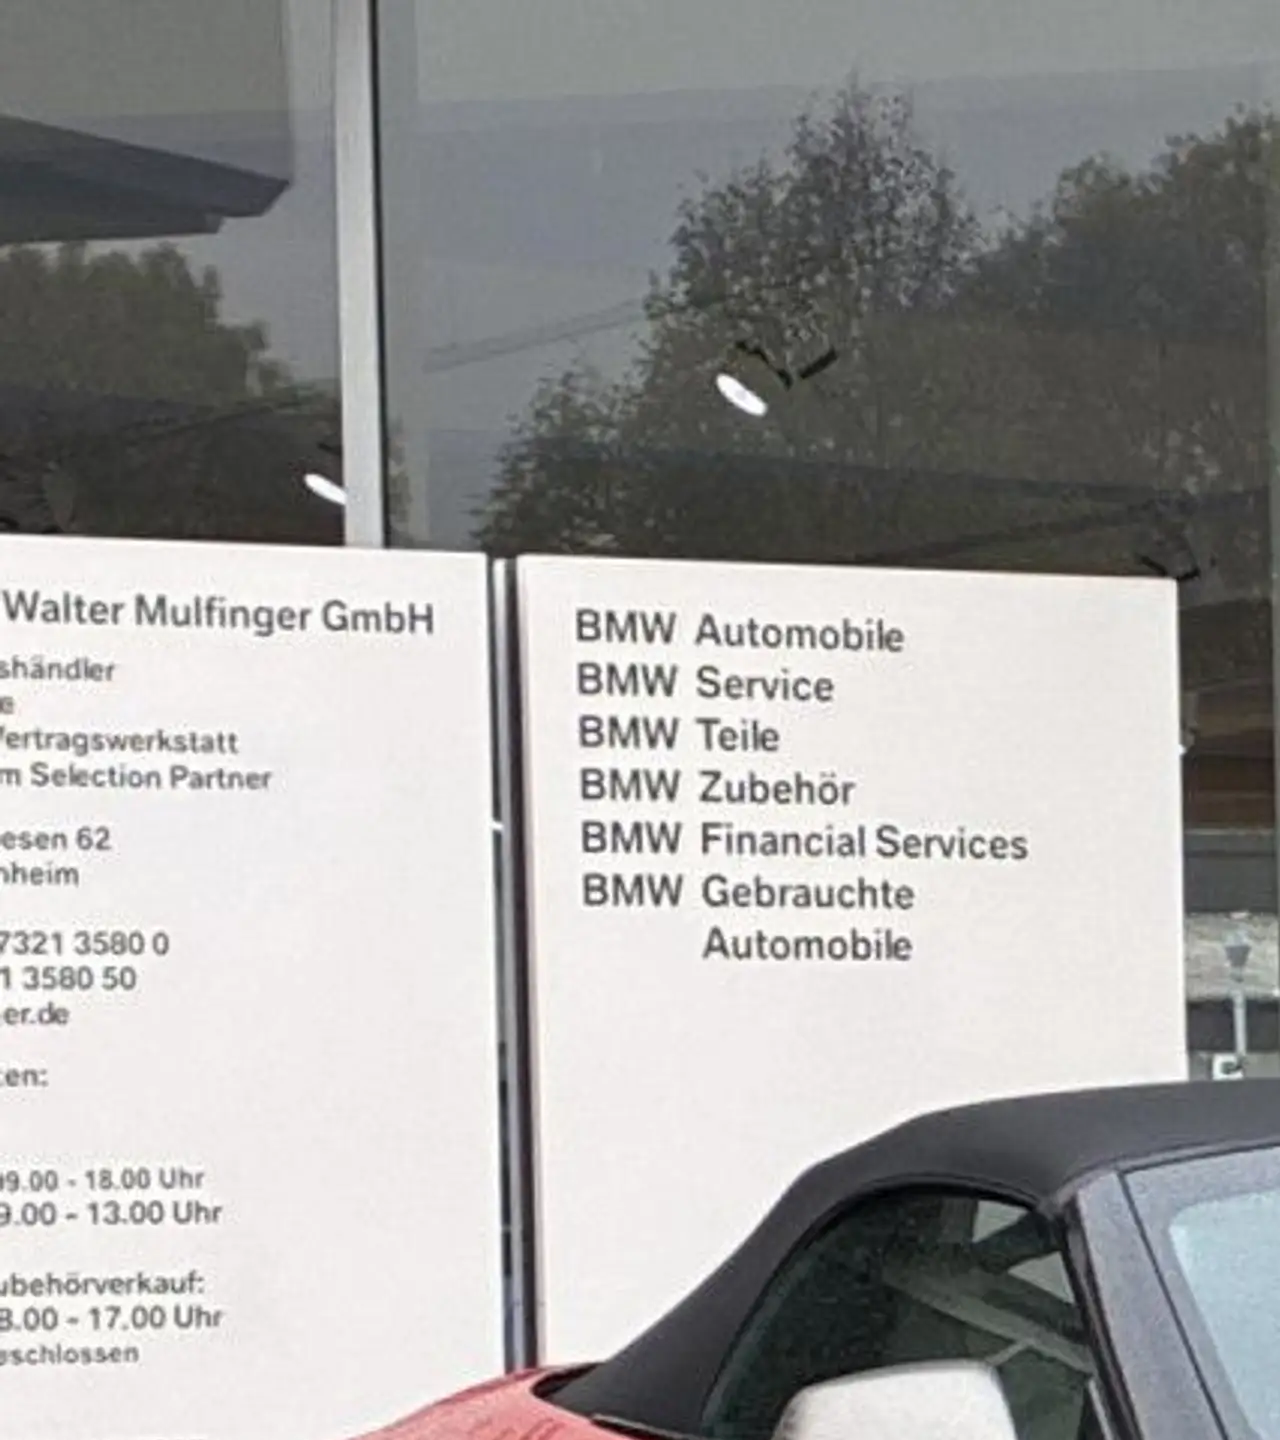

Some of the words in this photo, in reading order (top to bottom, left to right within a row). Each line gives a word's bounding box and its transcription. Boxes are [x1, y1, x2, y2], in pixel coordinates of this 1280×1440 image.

[2, 589, 125, 626] Walter
[135, 593, 312, 638] Mulfinger
[321, 599, 434, 635] GmbH
[575, 608, 677, 645] BMW
[694, 612, 905, 653] Automobile
[577, 661, 678, 698] BMW
[696, 664, 835, 703] Service
[0, 725, 238, 757] ertragswerkstatt
[578, 714, 680, 750] BMW
[695, 717, 780, 753] Teile
[30, 761, 162, 789] Selection
[169, 765, 272, 791] Partner
[580, 767, 681, 803] BMW
[699, 769, 856, 806] Zubehör
[75, 826, 111, 851] 62
[581, 819, 683, 855] BMW
[701, 821, 866, 858] Financial
[875, 825, 1029, 861] Services
[582, 872, 684, 907] BMW
[701, 873, 915, 911] Gebrauchte
[74, 930, 146, 956] 3580
[152, 931, 170, 956] 0
[702, 925, 913, 962] Automobile
[23, 965, 94, 991] 3580
[102, 965, 137, 991] 50
[0, 1068, 48, 1088] en:
[85, 1168, 152, 1191] 18.00
[158, 1168, 204, 1190] Uhr
[88, 1199, 165, 1226] 13.00
[173, 1200, 223, 1225] Uhr
[89, 1304, 167, 1330] 17.00
[173, 1304, 222, 1329] Uhr
